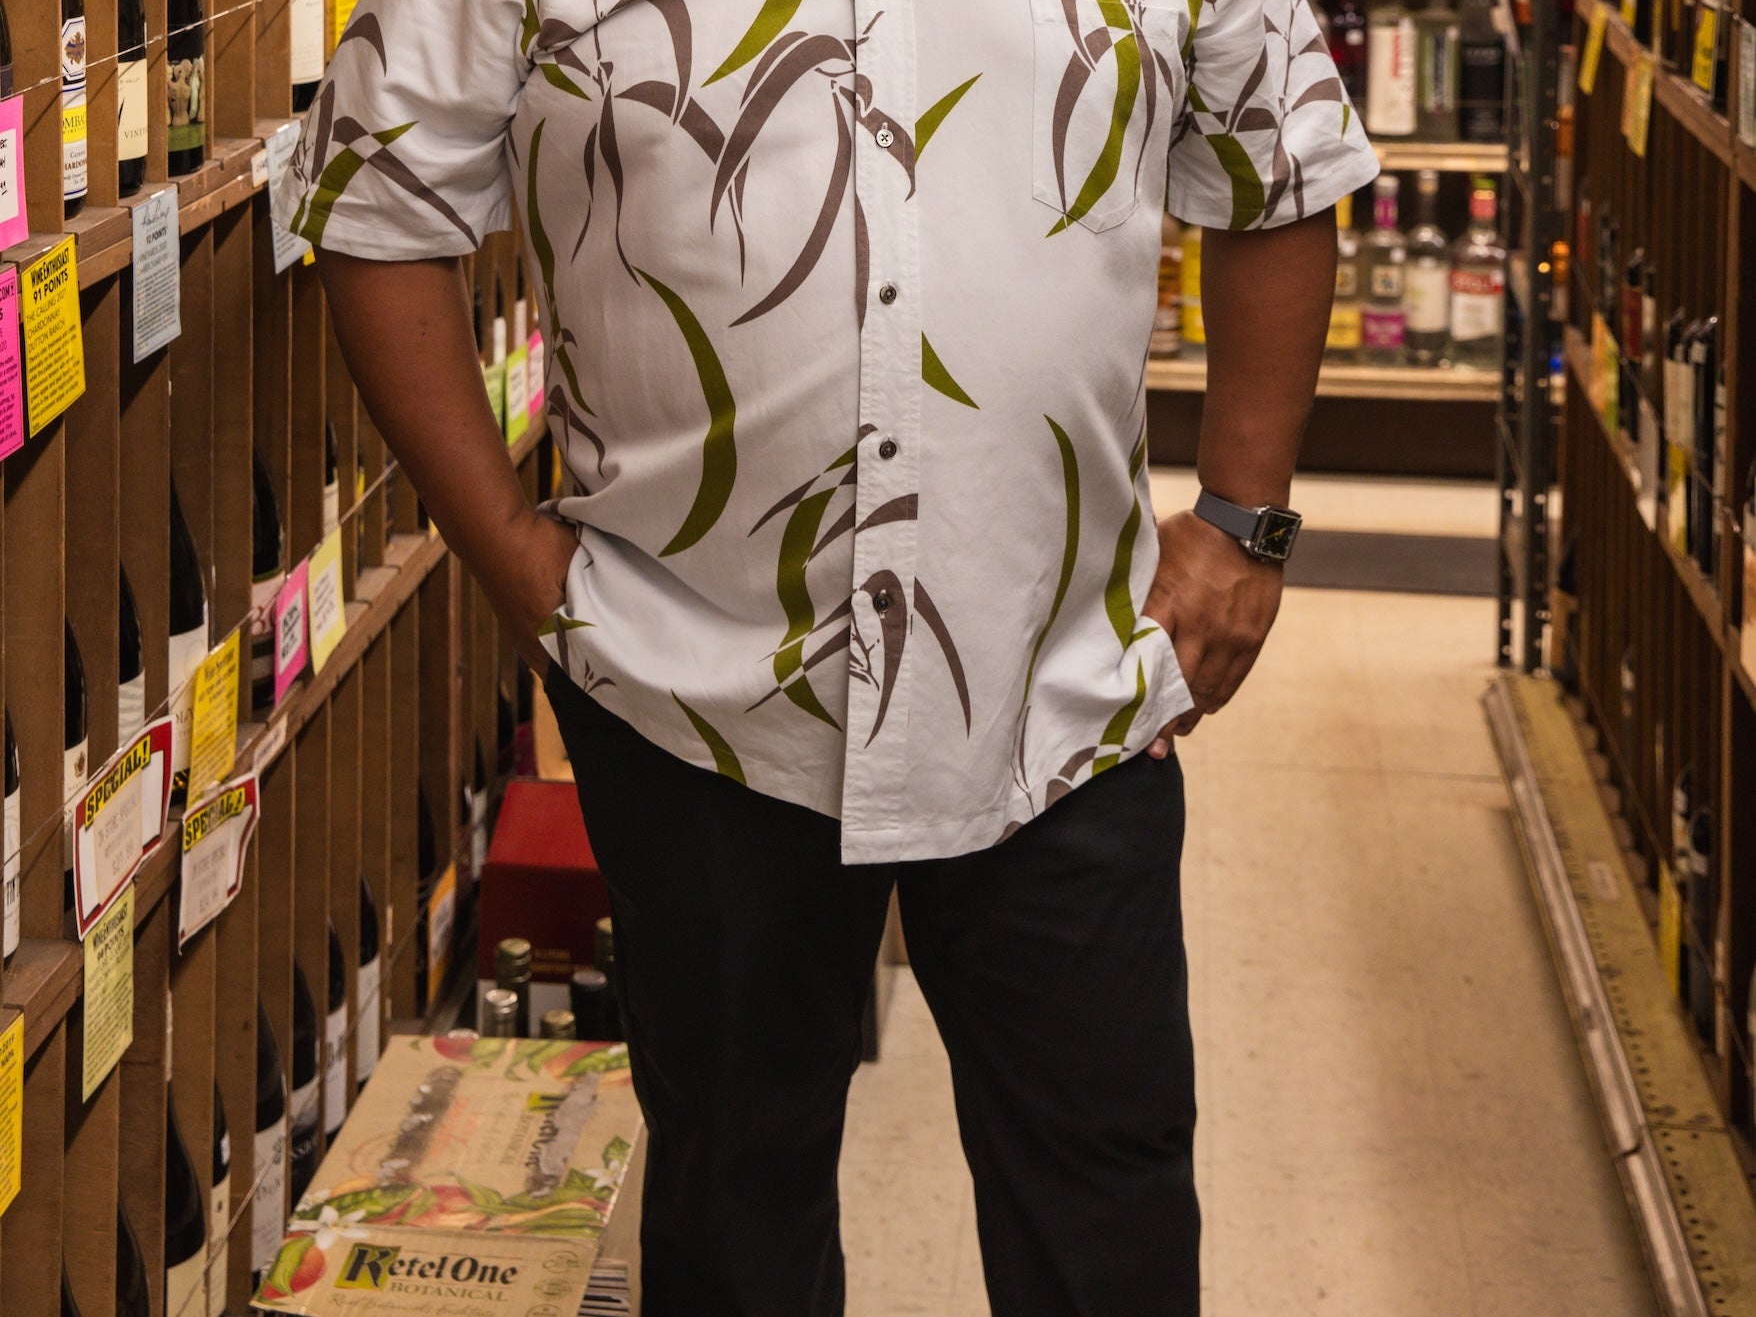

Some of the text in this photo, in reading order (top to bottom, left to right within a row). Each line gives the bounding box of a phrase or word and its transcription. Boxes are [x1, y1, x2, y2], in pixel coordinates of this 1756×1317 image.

[151, 226, 168, 243] POINTS
[33, 268, 68, 305] 91 POINTS
[87, 739, 148, 822] SPECIAL!
[185, 787, 243, 847] SPECIAL!
[345, 1247, 518, 1287] Ketel One
[390, 1281, 509, 1302] BOTANICAL
